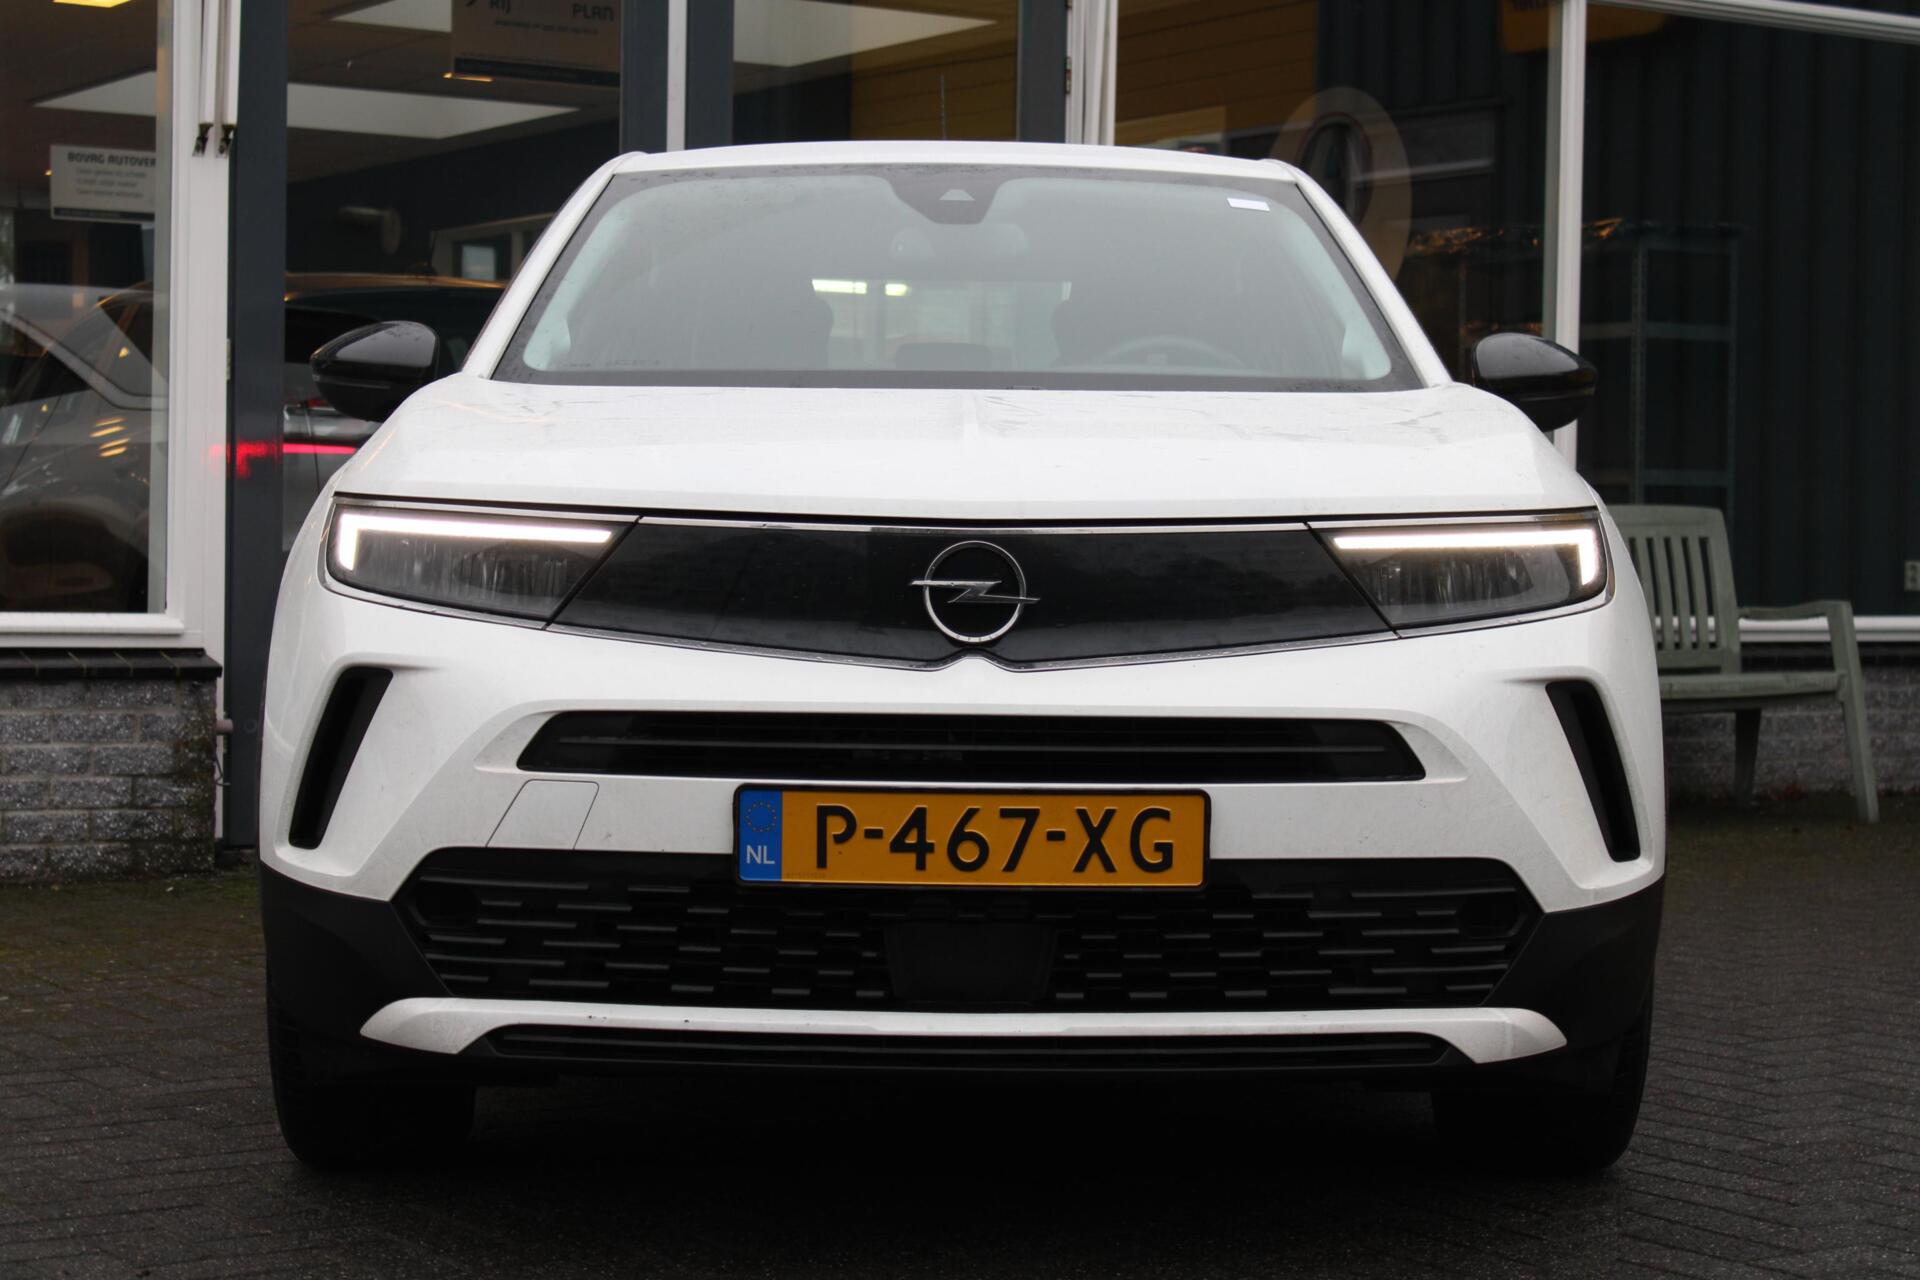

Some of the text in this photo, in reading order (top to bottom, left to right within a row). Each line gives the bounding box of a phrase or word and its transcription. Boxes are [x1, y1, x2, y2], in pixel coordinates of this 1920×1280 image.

[572, 3, 615, 21] PLAN
[67, 151, 104, 164] BOVAG
[816, 804, 1175, 873] P-467-XG
[746, 844, 776, 865] NL
